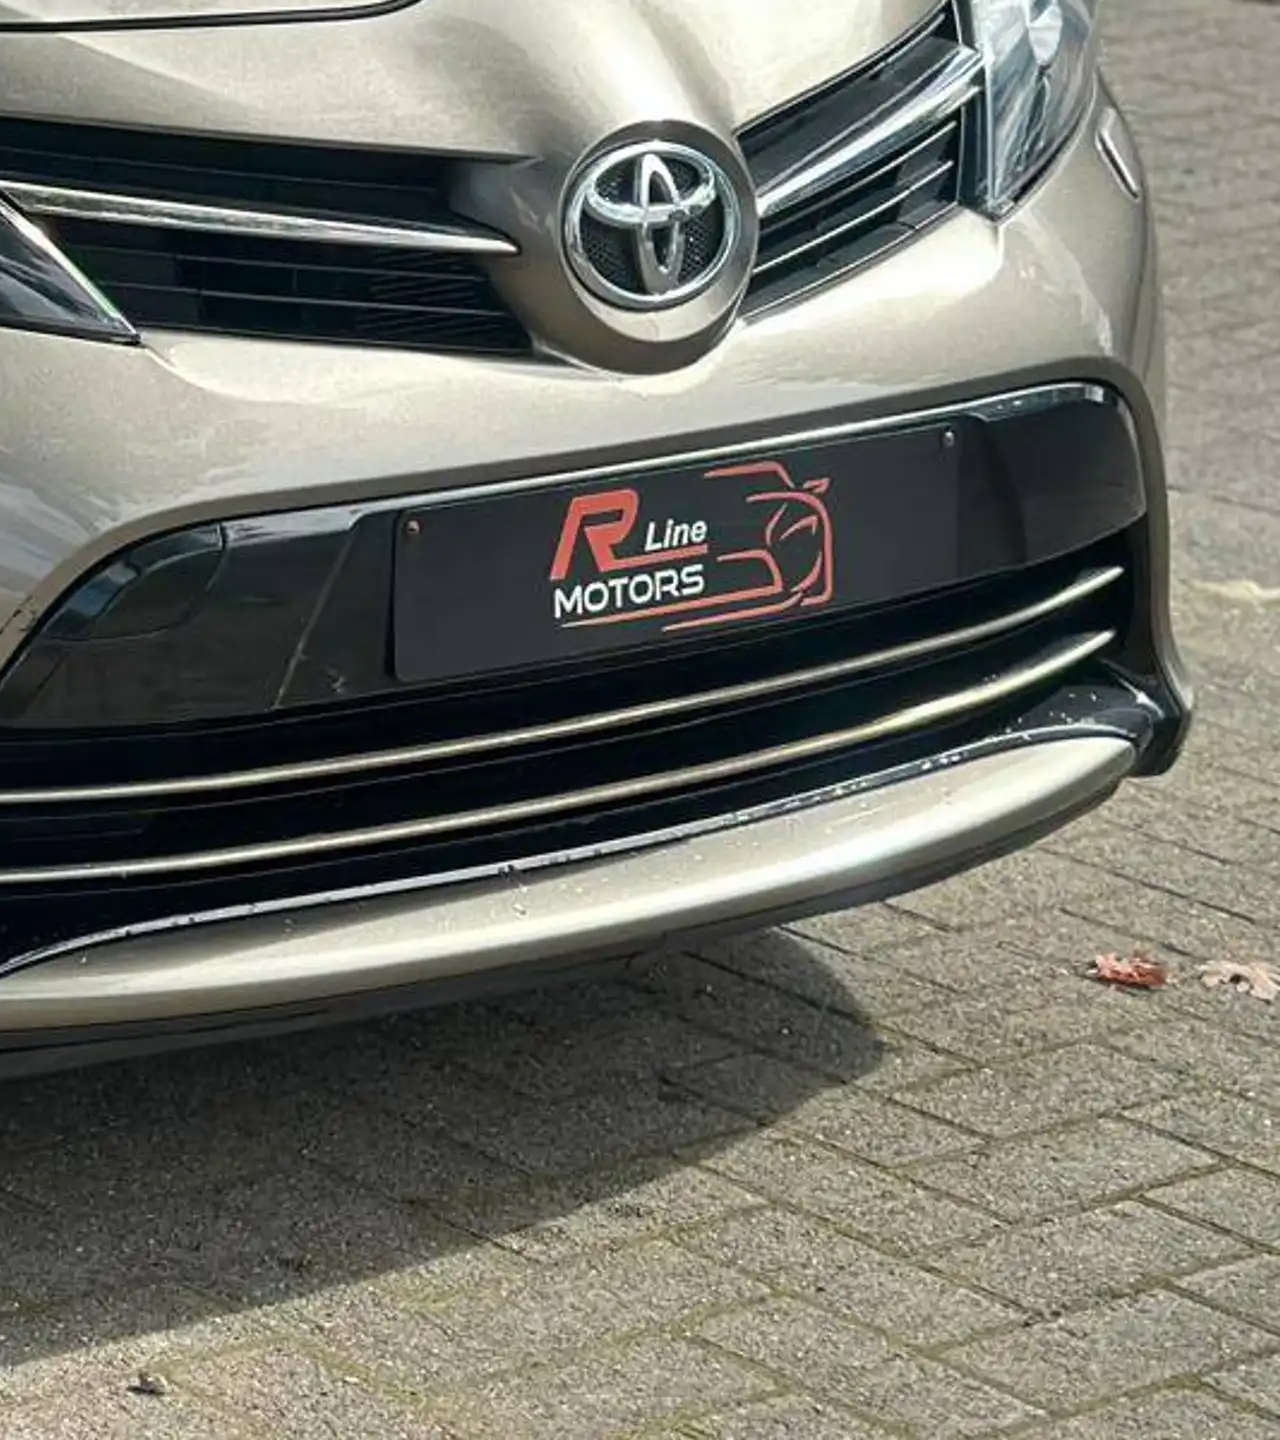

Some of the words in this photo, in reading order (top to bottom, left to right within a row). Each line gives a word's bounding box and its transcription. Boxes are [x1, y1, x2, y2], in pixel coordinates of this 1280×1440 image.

[550, 488, 640, 582] R
[644, 518, 708, 552] Line
[553, 563, 705, 619] MOTORS
